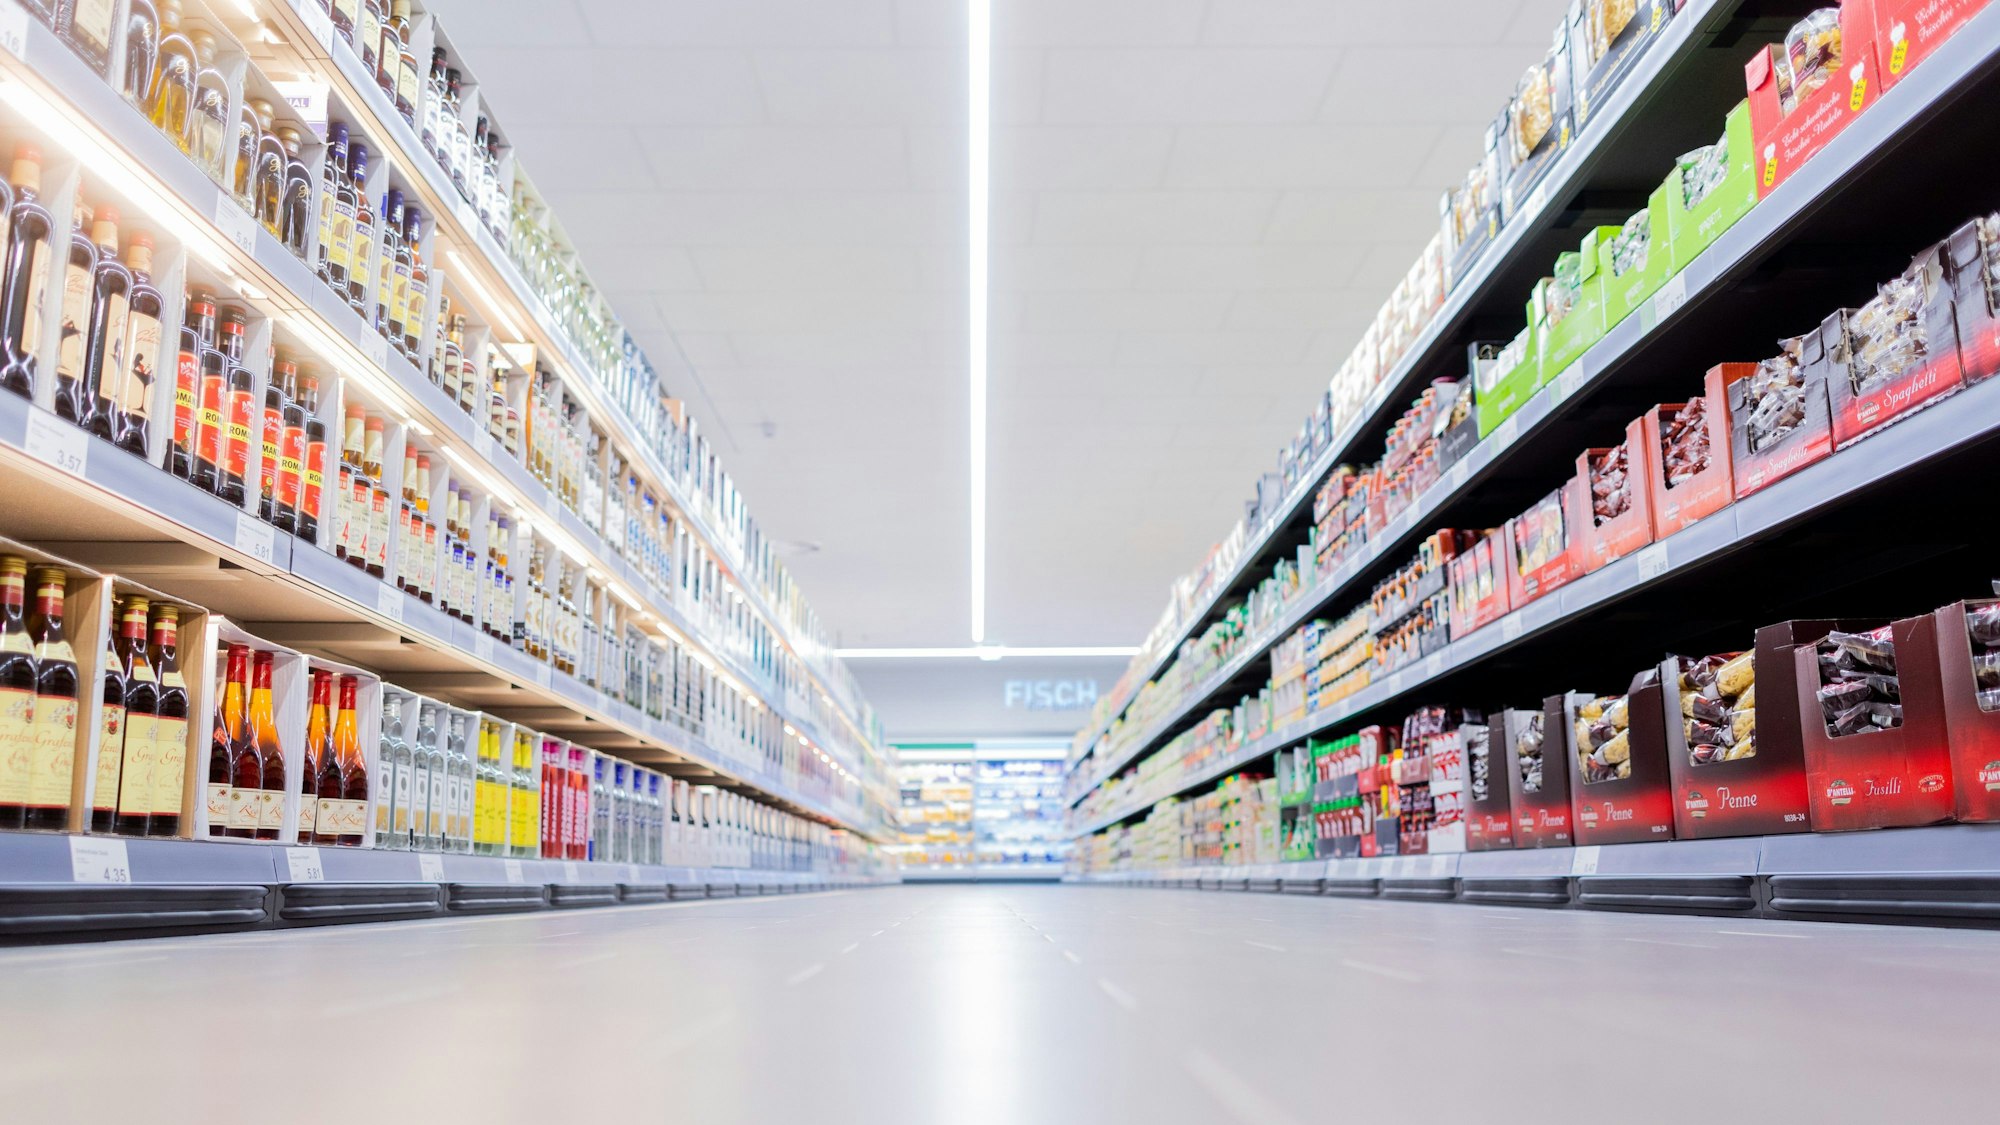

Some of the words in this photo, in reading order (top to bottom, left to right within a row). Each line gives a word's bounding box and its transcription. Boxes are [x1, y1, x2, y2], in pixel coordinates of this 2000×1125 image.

[1884, 368, 1937, 410] Spaghetti
[57, 449, 81, 473] 3.57
[254, 543, 270, 560] 5.81
[1004, 679, 1098, 706] FISCH
[1864, 777, 1902, 797] Fusilli
[1717, 786, 1757, 810] Penne
[1603, 802, 1633, 822] Penne
[104, 867, 126, 882] 4.35
[307, 867, 321, 880] 5.81
